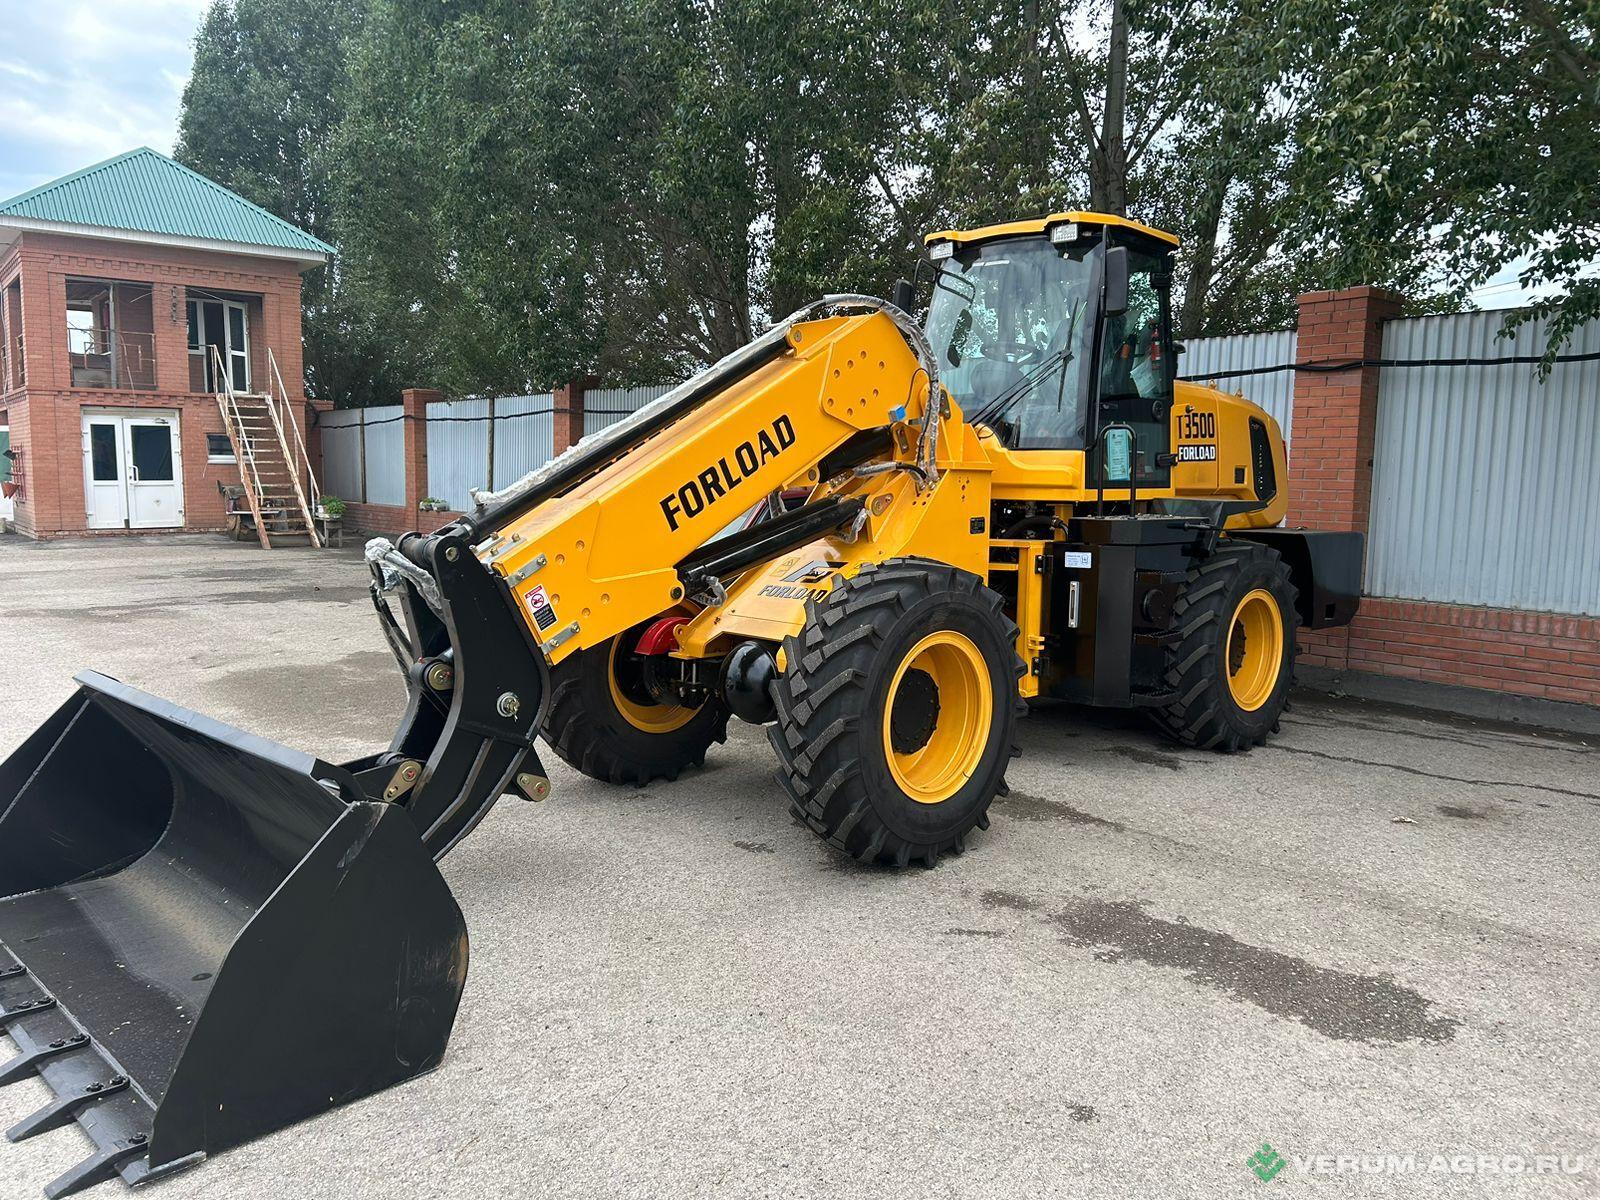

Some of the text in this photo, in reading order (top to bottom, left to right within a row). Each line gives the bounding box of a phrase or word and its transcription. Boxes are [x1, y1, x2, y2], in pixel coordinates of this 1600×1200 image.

[1177, 413, 1215, 439] T3500
[1178, 446, 1216, 460] FORLOAD
[659, 413, 796, 533] FORLOAD
[758, 585, 828, 601] FORLOAD
